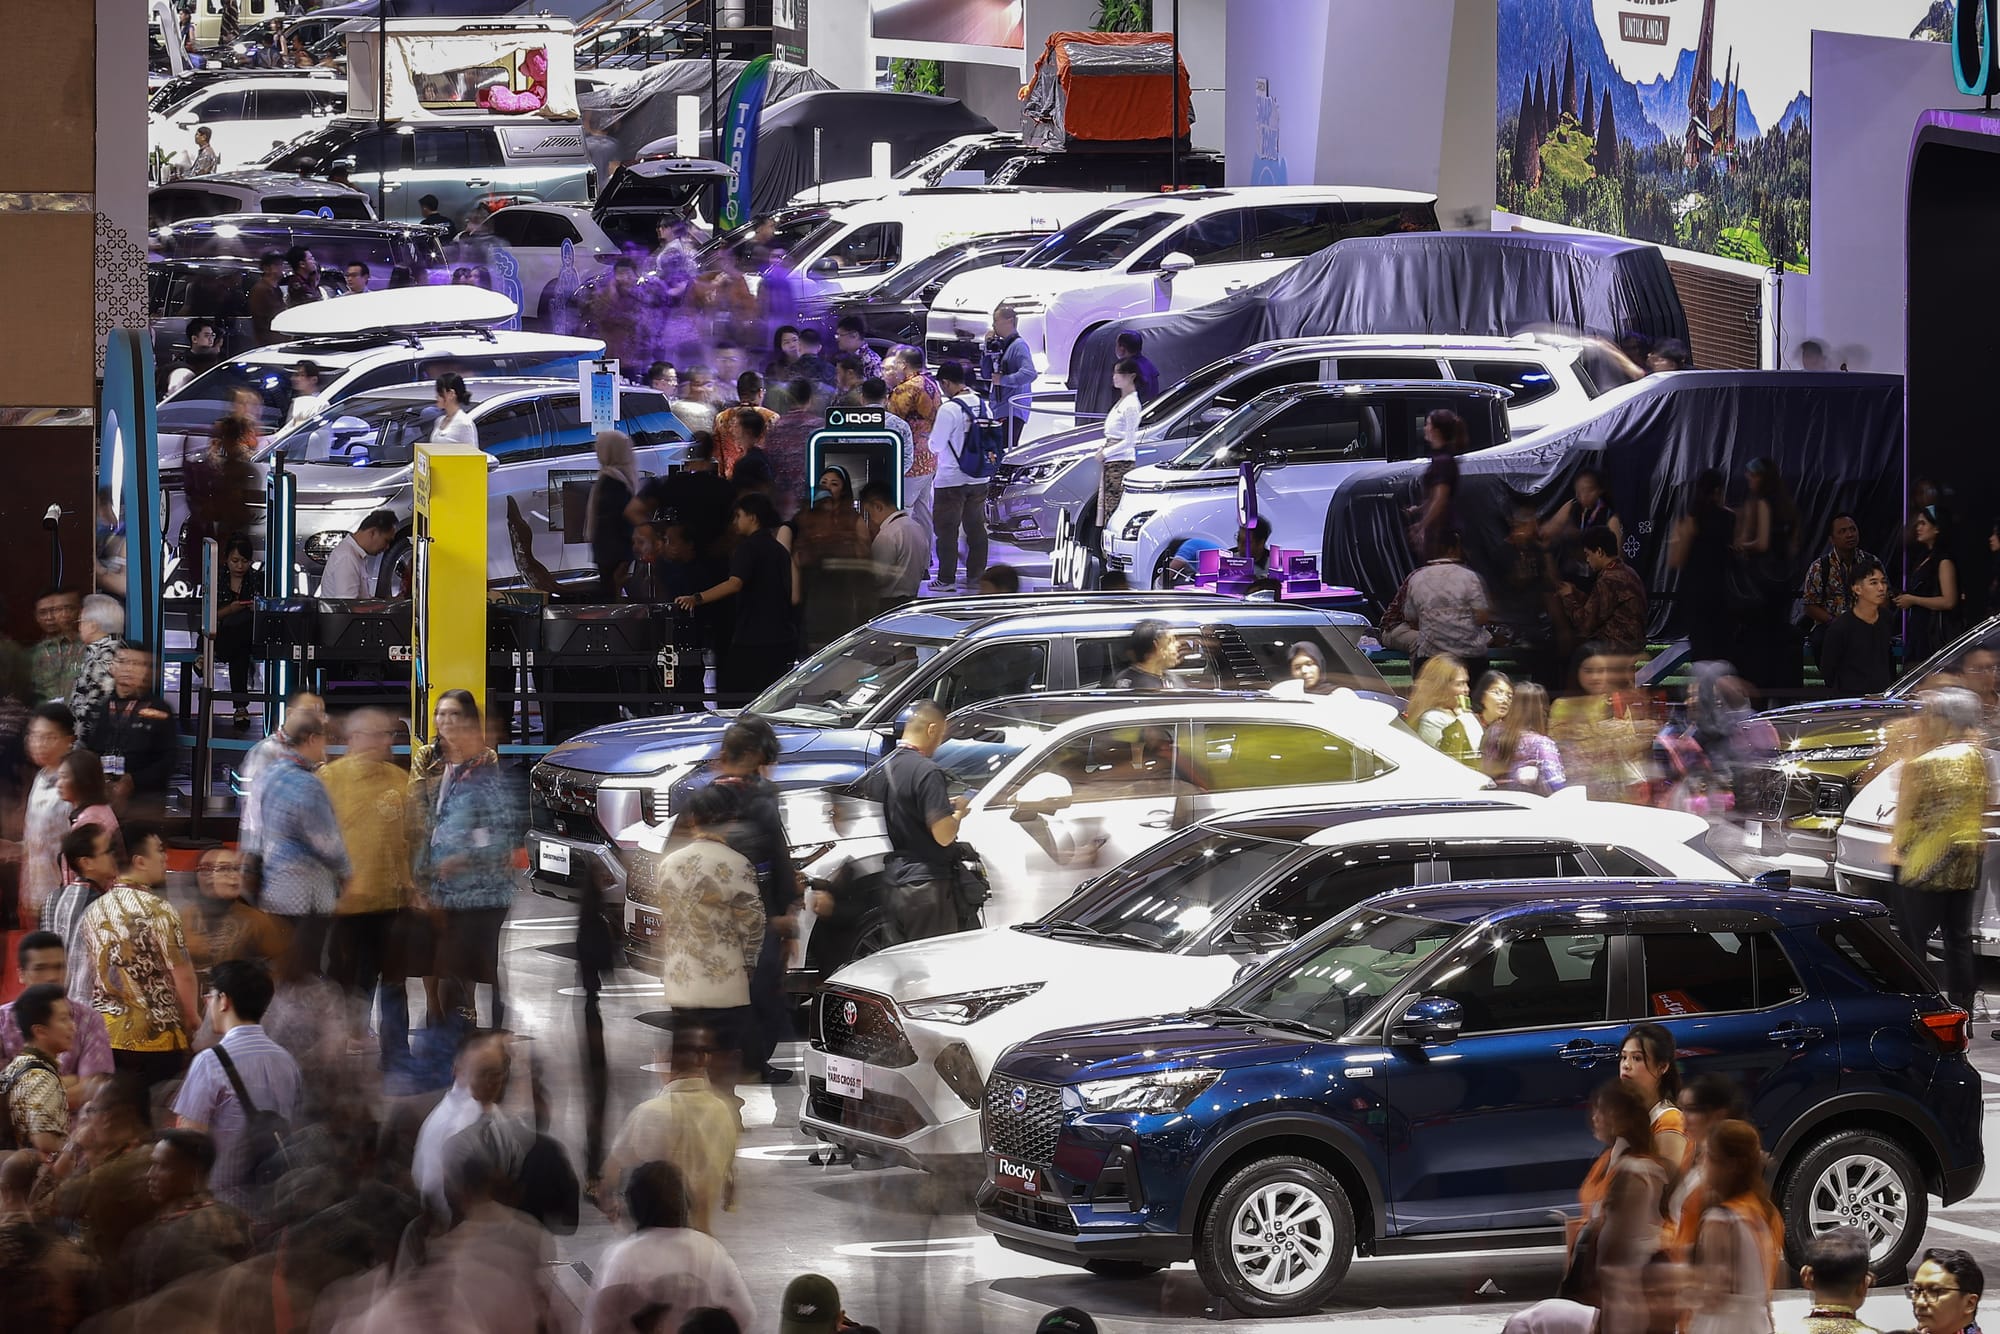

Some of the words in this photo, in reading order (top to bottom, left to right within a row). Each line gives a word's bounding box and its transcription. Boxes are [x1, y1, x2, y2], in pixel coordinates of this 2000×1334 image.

[1624, 17, 1644, 39] UNTUK
[1645, 19, 1664, 41] ANDA
[845, 412, 883, 424] IQOS
[827, 1071, 841, 1084] YARIS
[841, 1075, 856, 1088] CROSS
[999, 1158, 1036, 1183] Rocky
